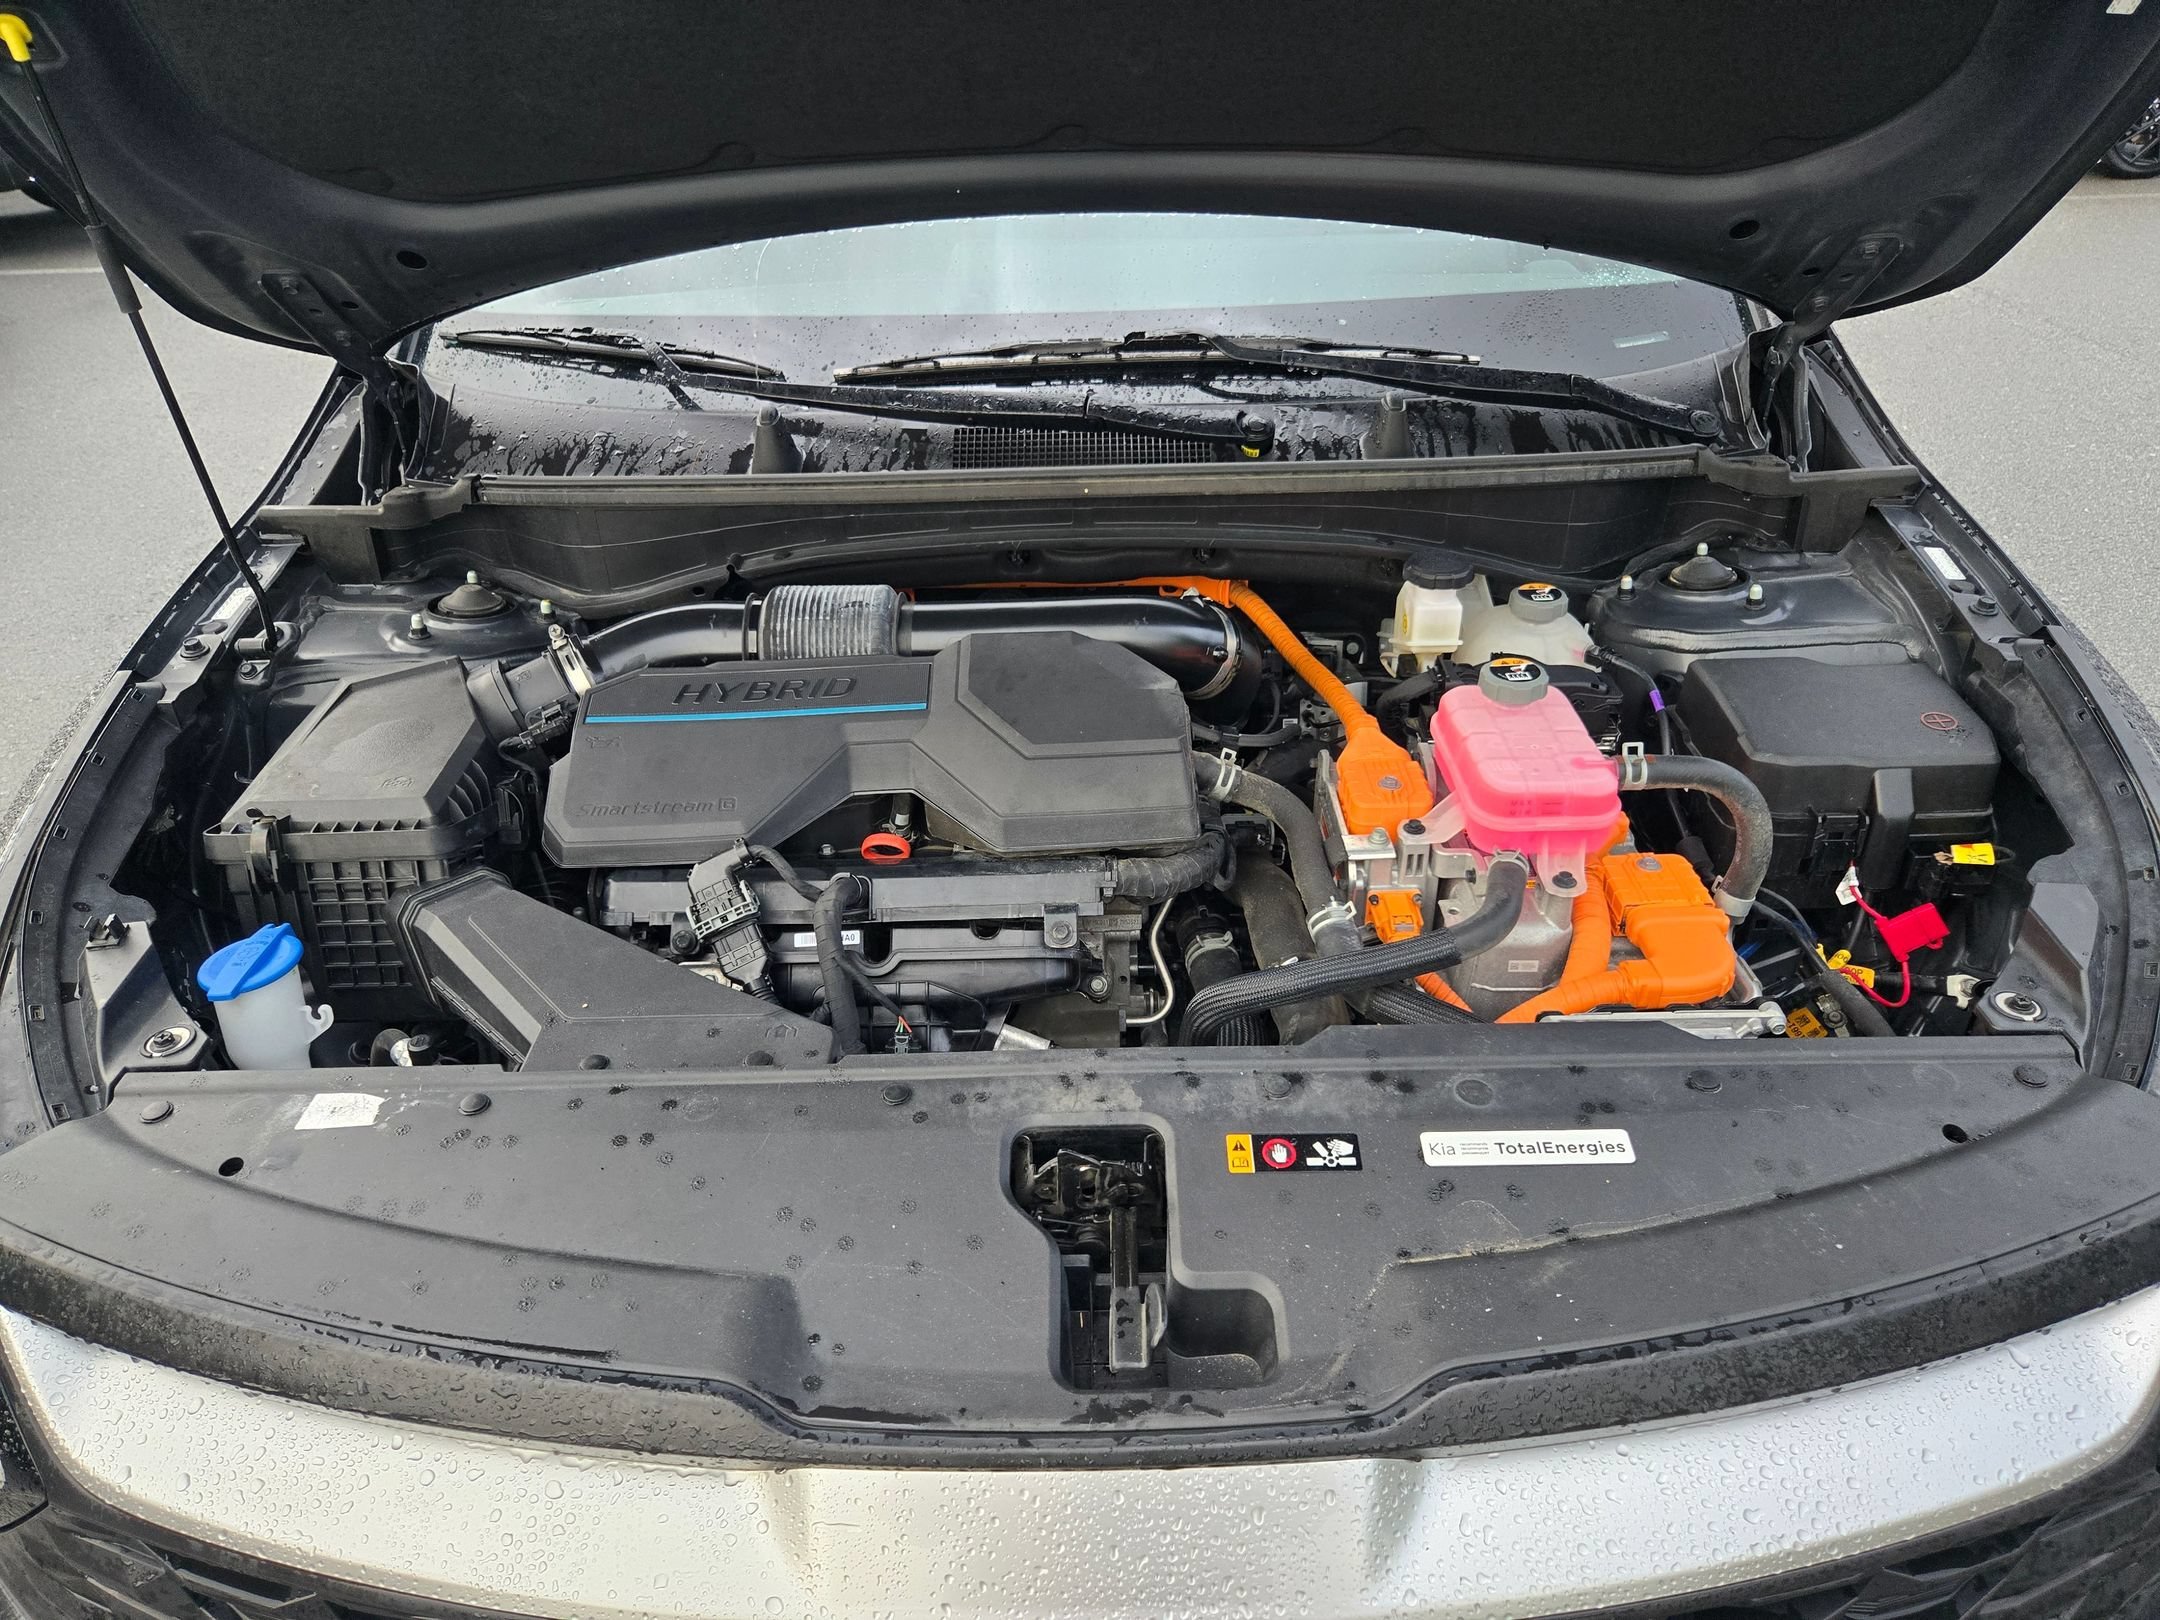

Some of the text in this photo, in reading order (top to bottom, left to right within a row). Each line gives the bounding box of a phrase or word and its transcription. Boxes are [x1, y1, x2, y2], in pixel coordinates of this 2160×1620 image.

[671, 677, 857, 706] HYBRID
[575, 800, 713, 817] Smartstream
[1429, 1140, 1626, 1156] Kia TotalEnergies
